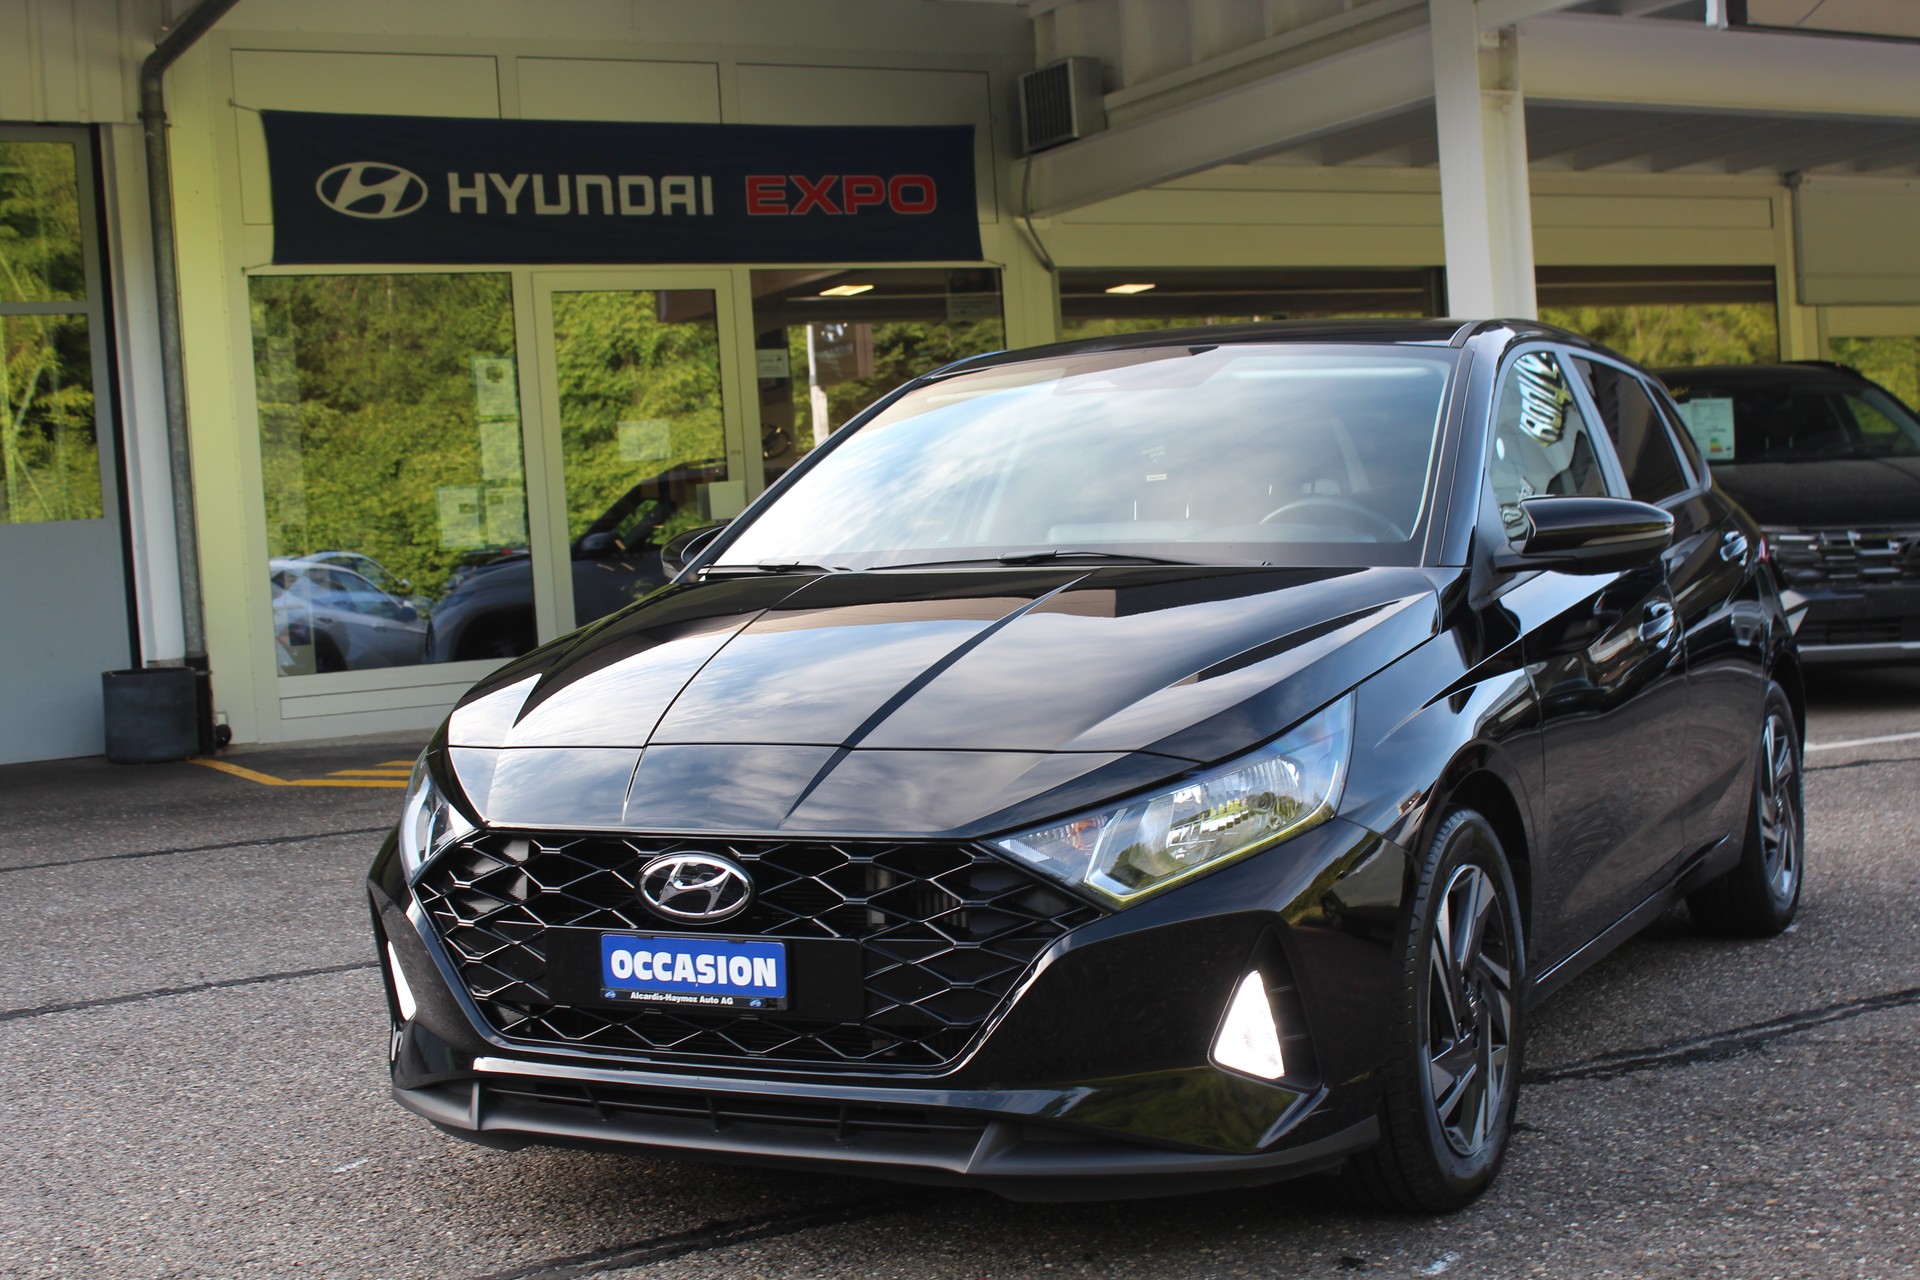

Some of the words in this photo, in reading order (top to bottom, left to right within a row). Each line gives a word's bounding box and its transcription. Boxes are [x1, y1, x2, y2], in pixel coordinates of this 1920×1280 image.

[448, 172, 714, 216] HYUNDAI
[745, 174, 937, 216] EXPO
[610, 949, 777, 988] OCCASION
[698, 995, 720, 1005] Auto
[720, 996, 734, 1006] AG
